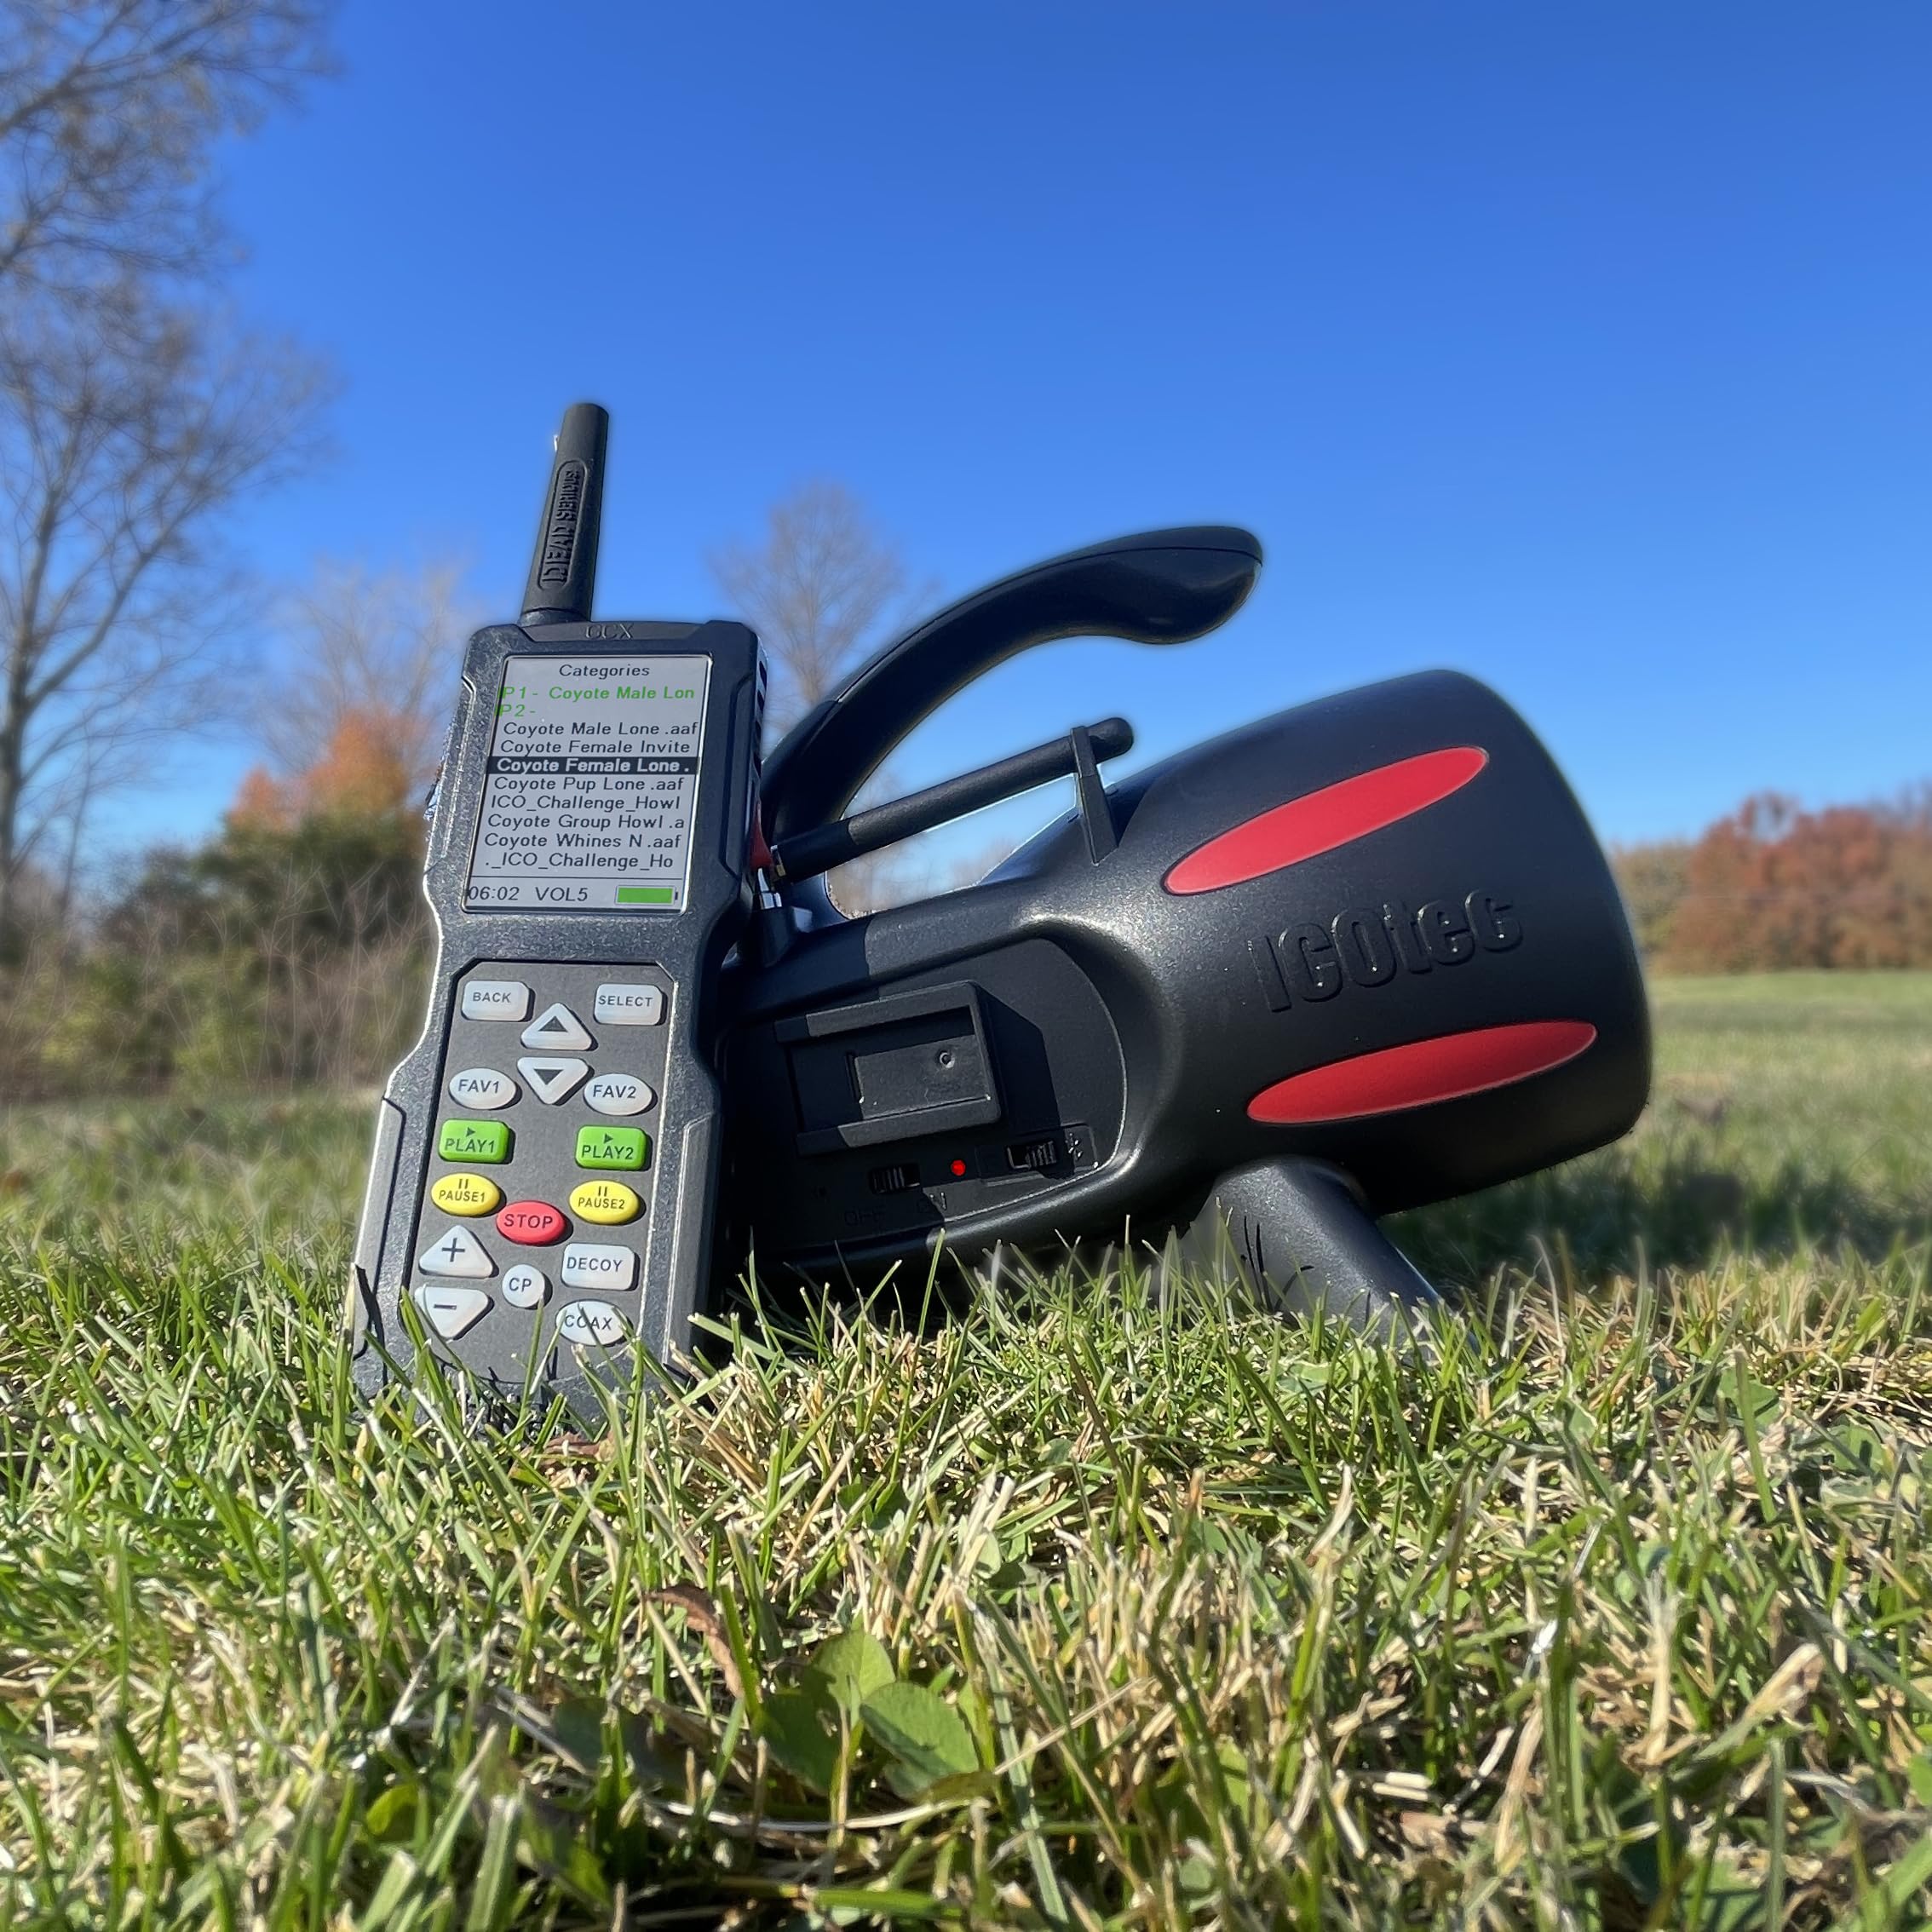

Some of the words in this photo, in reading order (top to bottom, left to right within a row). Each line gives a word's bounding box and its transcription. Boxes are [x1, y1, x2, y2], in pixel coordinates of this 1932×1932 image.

[543, 526, 575, 583] DEAD
[559, 664, 650, 680] Categories
[549, 687, 610, 702] Coyote
[616, 687, 657, 699] Male
[664, 687, 694, 699] Lon
[503, 722, 564, 738] Coyote
[572, 722, 611, 735] Male
[500, 740, 561, 756] Coyote
[569, 740, 632, 753] Female
[641, 741, 690, 753] Invite
[497, 757, 560, 774] Coyote
[565, 757, 630, 773] Female
[494, 776, 555, 793] Coyote
[563, 777, 596, 793] Pup
[488, 814, 550, 831] Coyote
[558, 814, 611, 831] Group
[485, 833, 548, 849] Coyote
[556, 834, 621, 847] Whines
[469, 886, 520, 900] 06:02
[535, 887, 588, 901] VOL5
[472, 992, 511, 1003] BACK
[598, 994, 653, 1008] SELECT
[457, 1078, 501, 1095] FAV1
[592, 1084, 637, 1100] FAV2
[444, 1139, 496, 1154] PLAY1
[581, 1145, 635, 1161] PLAY2
[438, 1190, 486, 1204] PAUSE1
[578, 1197, 625, 1210] PAUSE2
[503, 1214, 554, 1228] STOP
[566, 1256, 624, 1273] DECOY
[509, 1277, 532, 1292] CP
[564, 1315, 613, 1331] COAX
